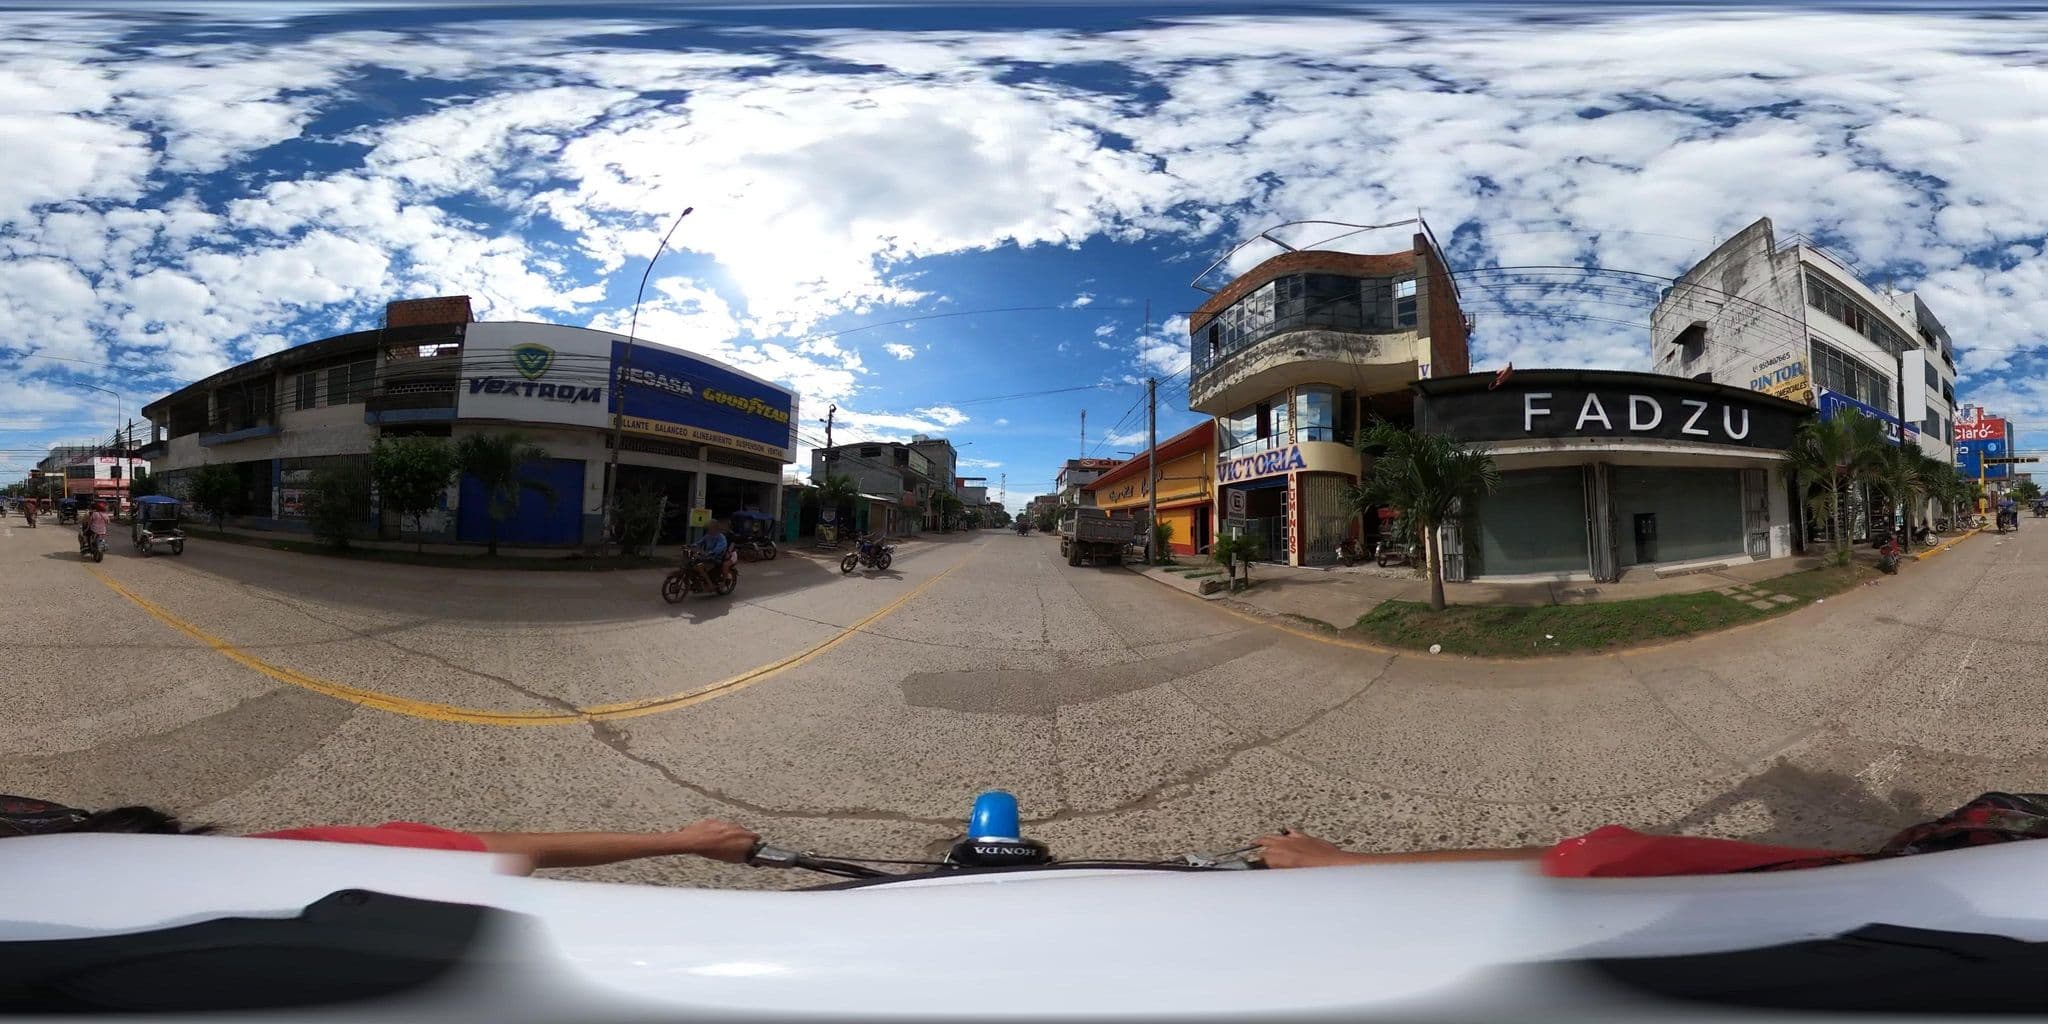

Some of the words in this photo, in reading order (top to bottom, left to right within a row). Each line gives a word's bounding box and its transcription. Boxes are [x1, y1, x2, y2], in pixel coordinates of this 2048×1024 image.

[702, 387, 788, 423] GOODYEAR
[1287, 386, 1295, 445] VIDRIOS
[1524, 392, 1749, 440] FADZU
[655, 423, 688, 436] BALANCEO
[1216, 445, 1307, 482] VICTORIA
[1288, 473, 1296, 554] ALUMINIOS
[973, 846, 1036, 857] HONDA
